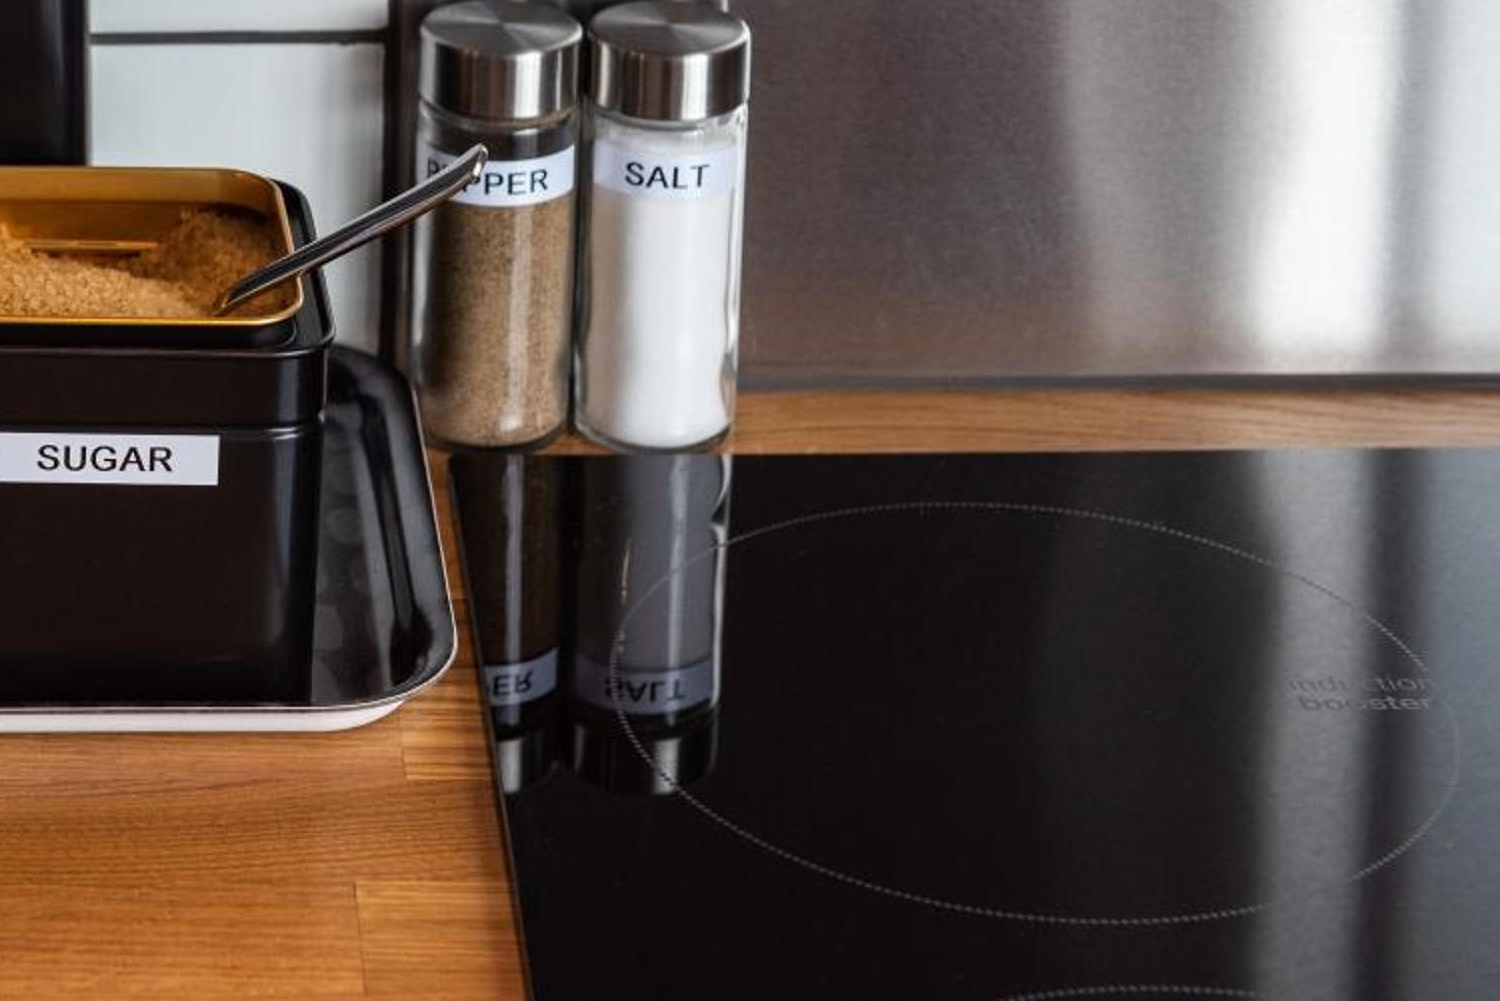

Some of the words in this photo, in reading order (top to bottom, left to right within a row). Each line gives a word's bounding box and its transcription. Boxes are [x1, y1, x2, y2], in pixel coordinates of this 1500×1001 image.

[427, 158, 549, 195] PPER
[624, 161, 710, 189] SALT
[37, 444, 173, 472] SUGAR
